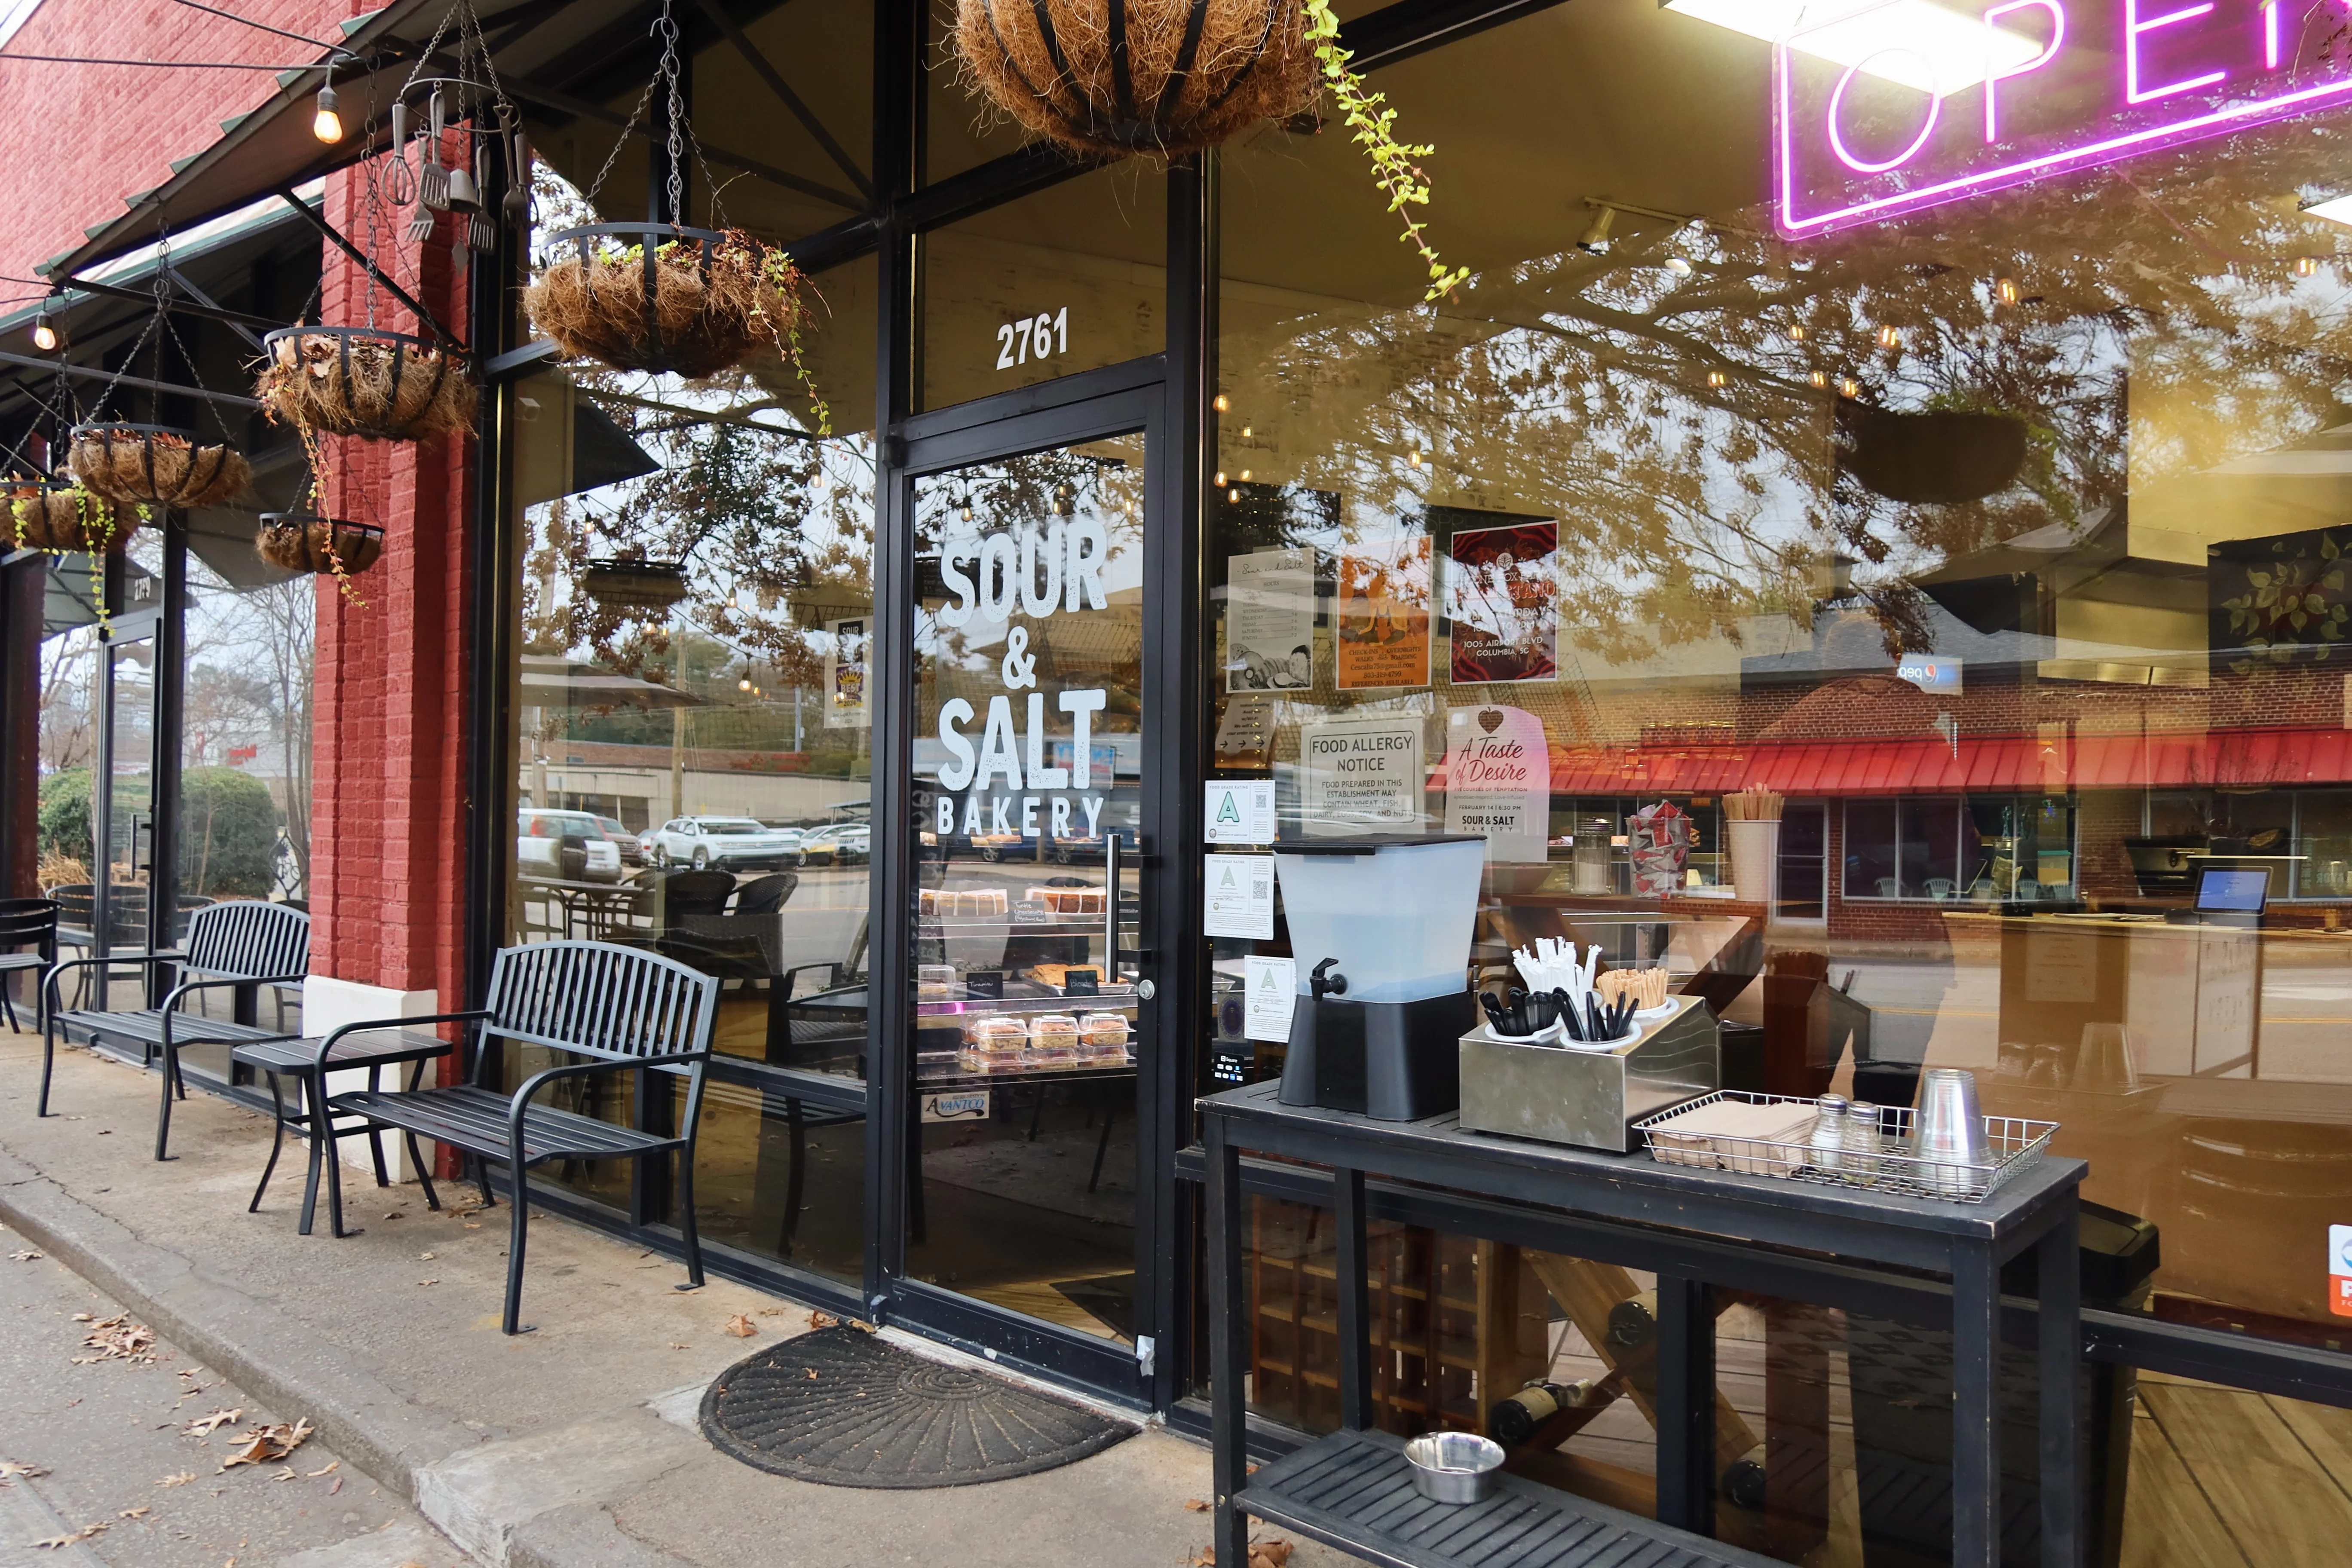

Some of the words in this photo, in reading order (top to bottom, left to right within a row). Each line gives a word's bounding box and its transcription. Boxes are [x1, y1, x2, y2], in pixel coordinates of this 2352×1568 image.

[996, 306, 1067, 371] 2761
[940, 519, 1108, 628] SOUR
[1243, 564, 1262, 574] Sour
[1262, 563, 1283, 572] and
[1502, 622, 1512, 631] TO
[1486, 638, 1519, 647] AIRPORT
[1522, 636, 1543, 644] BLVD
[1002, 625, 1036, 690] &
[1476, 648, 1517, 656] COLUMBIA,
[841, 683, 860, 693] BEST
[937, 689, 1106, 792] SALT
[1313, 740, 1348, 753] FOOD
[1352, 736, 1412, 751] ALLERGY
[1459, 738, 1473, 761] A
[1478, 737, 1524, 759] Taste
[1338, 757, 1385, 772] NOTICE
[1455, 763, 1467, 785] of
[1469, 759, 1527, 782] Desire
[1217, 791, 1240, 822] A
[1354, 800, 1381, 808] WHEAT,
[937, 796, 1104, 838] BAKERY
[1462, 816, 1484, 824] SOUR
[1493, 817, 1514, 825] SALT
[1221, 866, 1235, 886] A
[1261, 968, 1276, 989] A
[926, 1097, 984, 1113] AVANTCO
